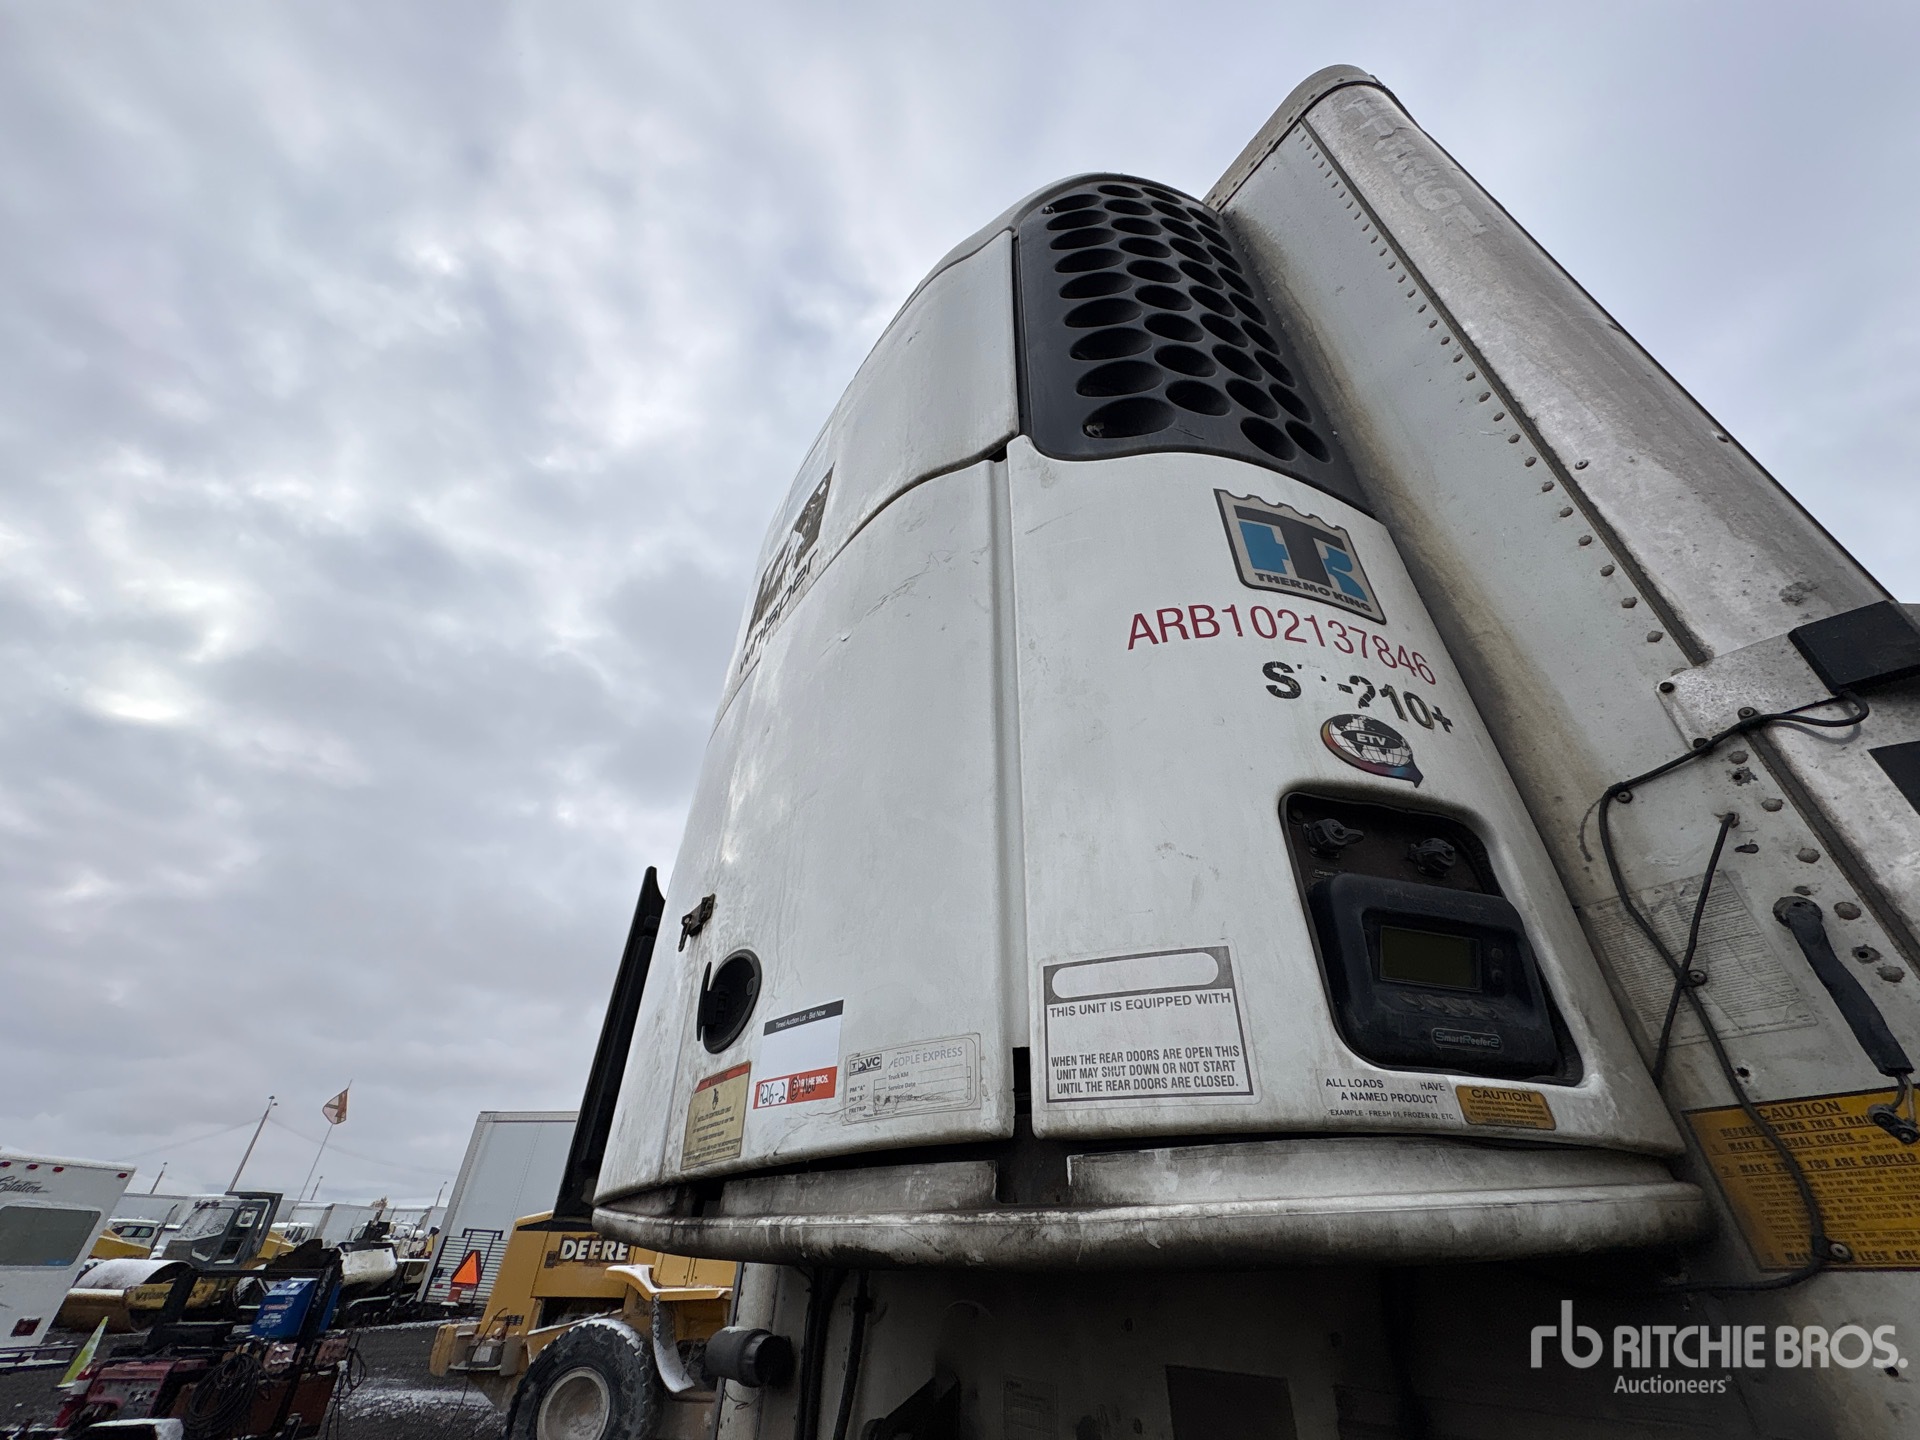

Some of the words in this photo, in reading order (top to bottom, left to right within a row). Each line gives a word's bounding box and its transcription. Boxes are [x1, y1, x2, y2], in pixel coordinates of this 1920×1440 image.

[1255, 572, 1331, 597] THERMO
[1332, 591, 1373, 613] KING
[1127, 603, 1436, 686] ARB102137846
[1356, 733, 1387, 746] ETV
[1050, 1006, 1076, 1018] THIS
[1079, 1002, 1106, 1014] UNIT
[1110, 1001, 1122, 1012] IS
[1126, 995, 1192, 1010] EQUIPPED
[1195, 992, 1232, 1004] WITH
[1435, 1031, 1500, 1048] SmartReefer2
[888, 1053, 920, 1069] EOPLE
[923, 1046, 963, 1063] EXPRESS
[1051, 1054, 1078, 1067] WHEN
[1079, 1053, 1097, 1065] THE
[1099, 1051, 1124, 1063] REAR
[1126, 1049, 1160, 1062] DOORS
[1162, 1048, 1183, 1060] ARE
[1184, 1046, 1212, 1058] OPEN
[1214, 1045, 1240, 1057] THIS
[1056, 1069, 1077, 1081] UNIT
[1079, 1067, 1099, 1079] MAY
[1101, 1065, 1127, 1078] SHUT
[1129, 1064, 1160, 1076] DOWN
[1162, 1062, 1177, 1074] OR
[1179, 1061, 1201, 1073] NOT
[1203, 1060, 1236, 1072] START
[888, 1084, 904, 1092] Service
[1057, 1082, 1083, 1094] UNTIL
[1085, 1080, 1103, 1092] THE
[1105, 1079, 1131, 1091] REAR
[1133, 1077, 1168, 1090] DOORS
[1170, 1076, 1192, 1088] ARE
[1193, 1074, 1239, 1088] CLOSED.
[1325, 1078, 1346, 1088] ALL
[1347, 1078, 1384, 1089] LOADS
[1420, 1081, 1446, 1092] HAVE
[1340, 1092, 1349, 1101] A
[1350, 1092, 1388, 1102] NAMED
[1390, 1093, 1438, 1104] PRODUCT
[1471, 1088, 1532, 1102] CAUTION
[1330, 1109, 1363, 1117] EXAMPLE
[1403, 1111, 1430, 1119] FROZEN
[1758, 1101, 1842, 1121] CAUTION
[1808, 1118, 1836, 1129] THIS
[1816, 1132, 1856, 1144] CHECK
[1834, 1156, 1857, 1167] ARE
[1861, 1152, 1917, 1166] COUPLED
[560, 1240, 629, 1260] DEERE
